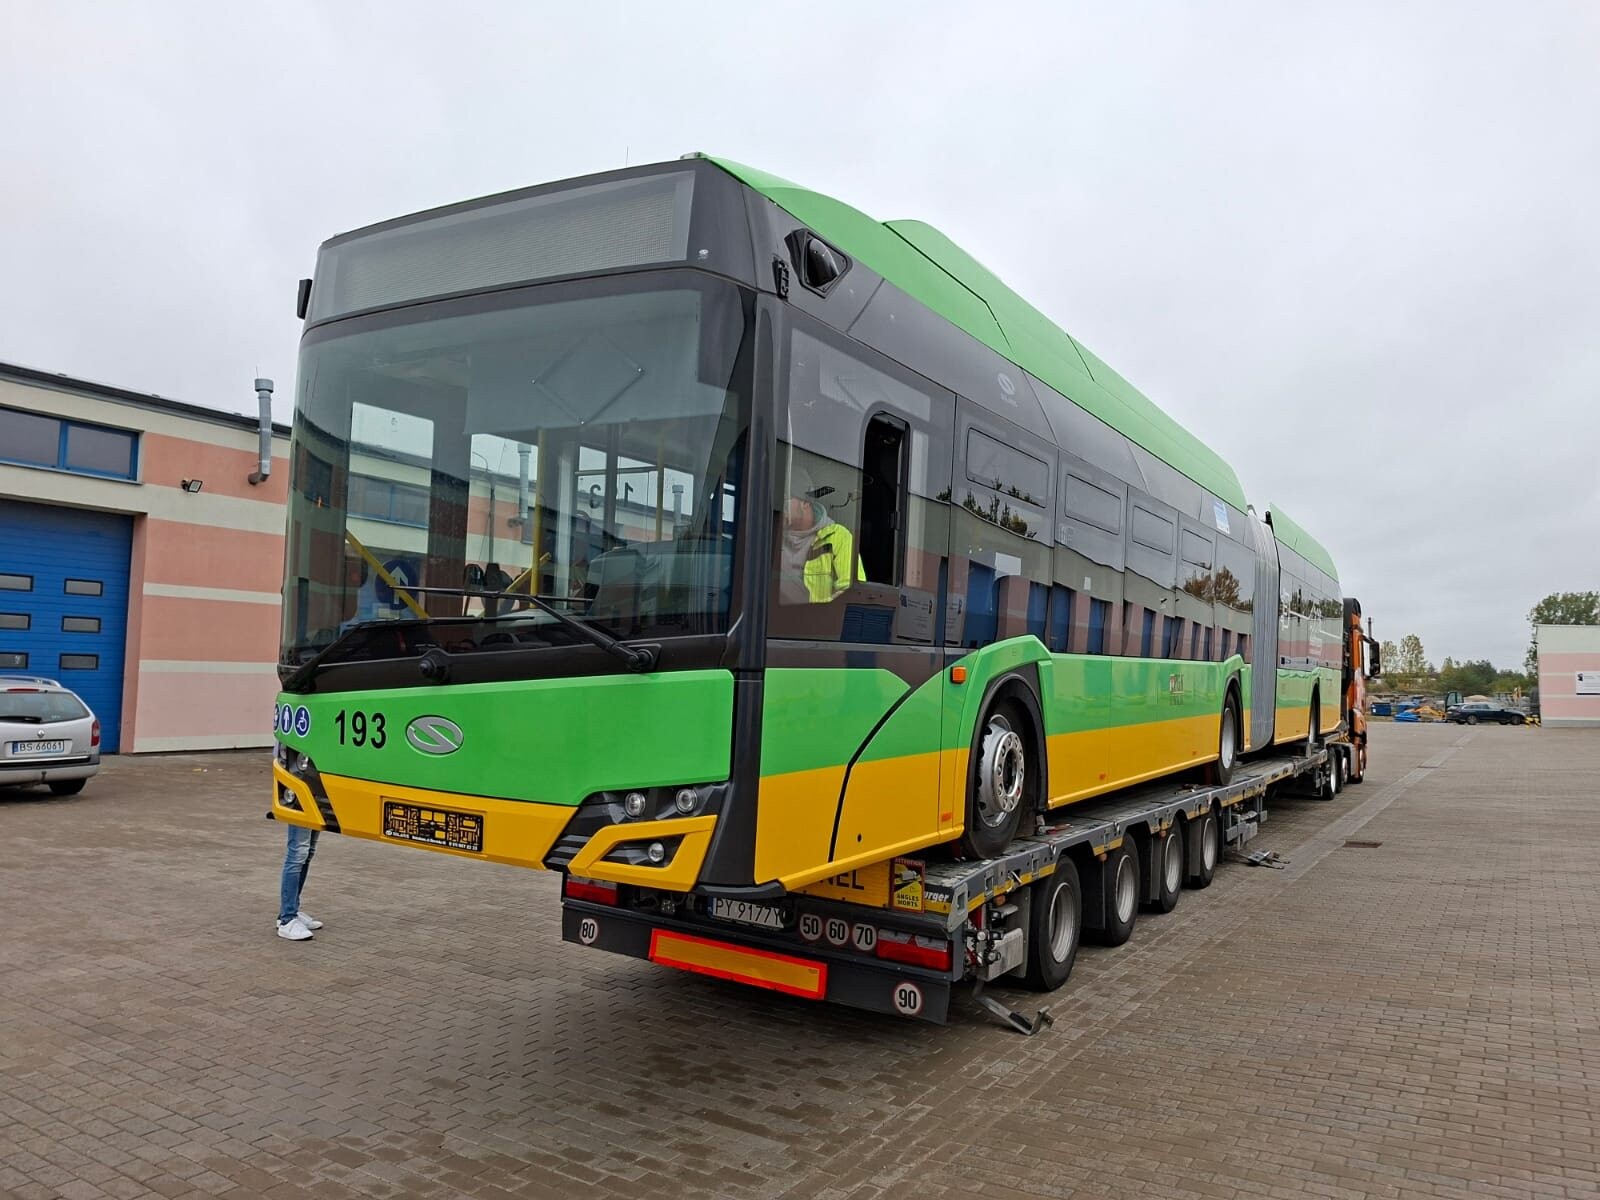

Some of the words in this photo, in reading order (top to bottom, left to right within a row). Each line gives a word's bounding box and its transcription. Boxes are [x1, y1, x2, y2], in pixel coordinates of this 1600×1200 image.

[334, 709, 387, 749] 193
[20, 743, 33, 752] BS
[35, 741, 62, 751] 66061
[896, 893, 919, 902] ANGLES
[715, 899, 733, 917] PY
[581, 921, 596, 939] 80
[802, 916, 819, 936] 50
[829, 921, 846, 941] 60
[856, 926, 873, 946] 70
[898, 988, 917, 1010] 90
